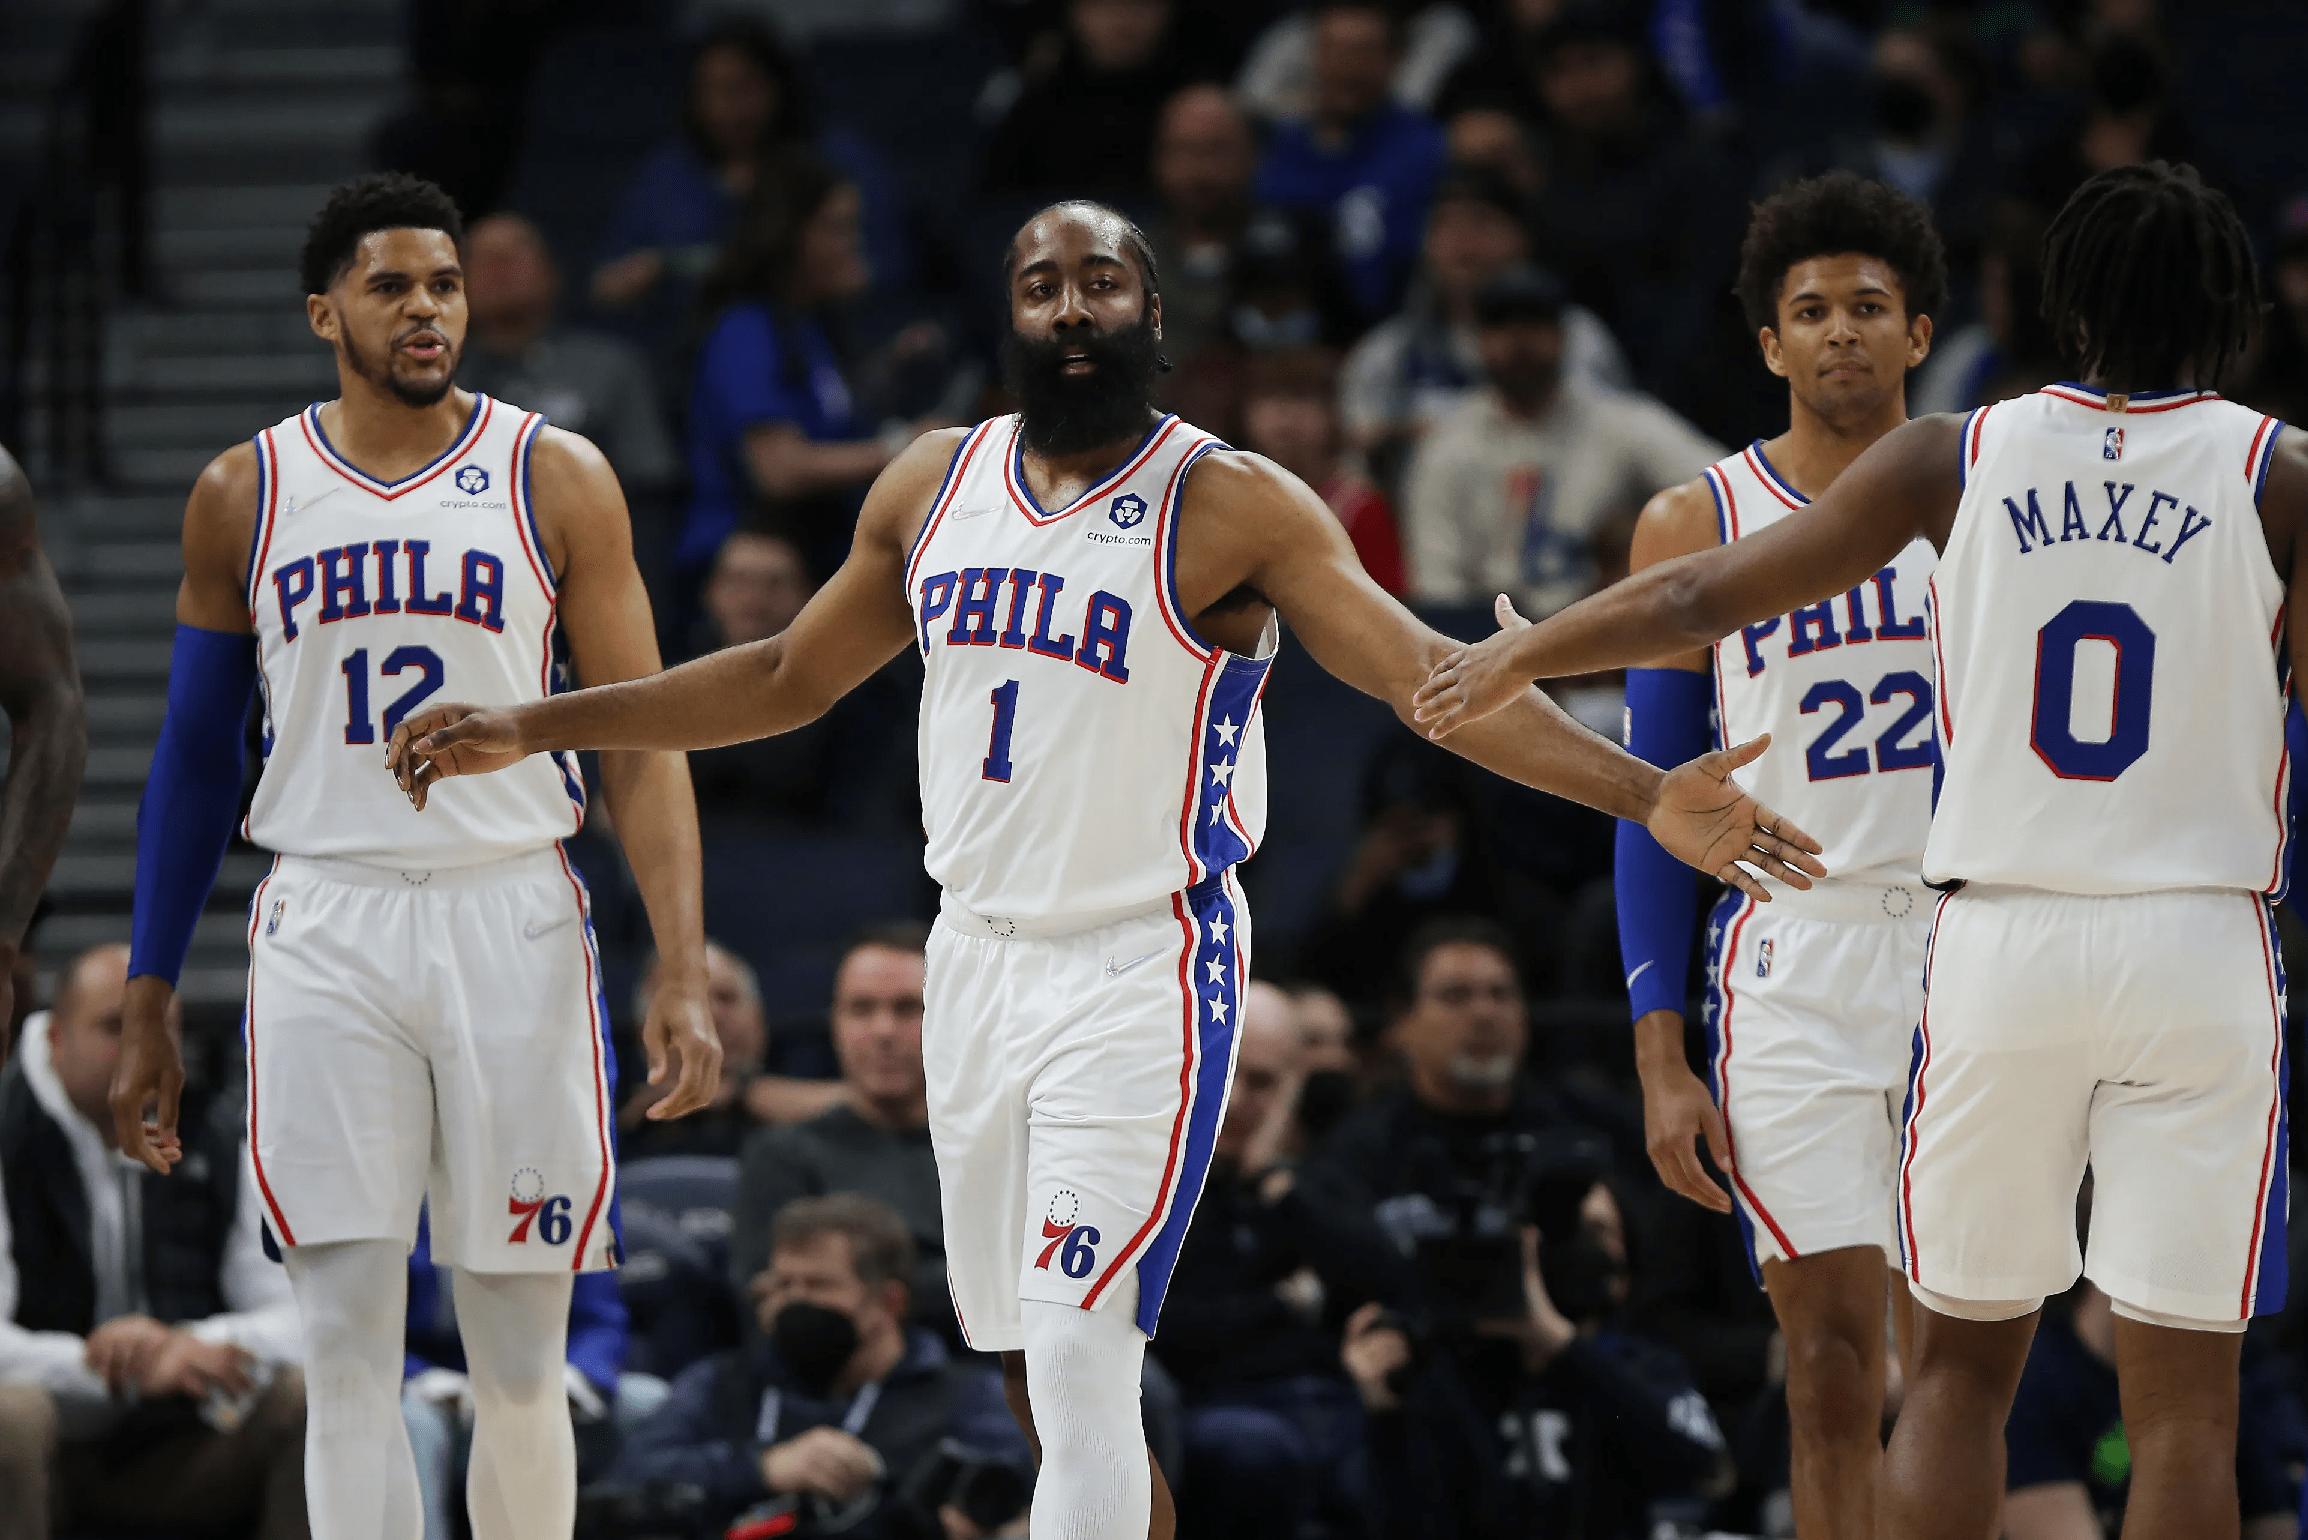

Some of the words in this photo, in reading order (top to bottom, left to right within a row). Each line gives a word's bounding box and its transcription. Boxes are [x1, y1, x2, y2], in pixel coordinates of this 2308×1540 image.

[440, 500, 506, 511] crypto.com
[1087, 531, 1151, 546] crypto.com
[2002, 480, 2212, 564] MAXEY
[273, 539, 505, 643] PHILA
[920, 567, 1133, 685] PHILA
[1740, 567, 1931, 679] PHIL
[341, 645, 444, 744] 12
[981, 679, 1020, 783] 1
[1800, 670, 1935, 782] 22
[2030, 600, 2157, 782] 0
[508, 1194, 572, 1245] 76
[1034, 1215, 1101, 1279] 76
